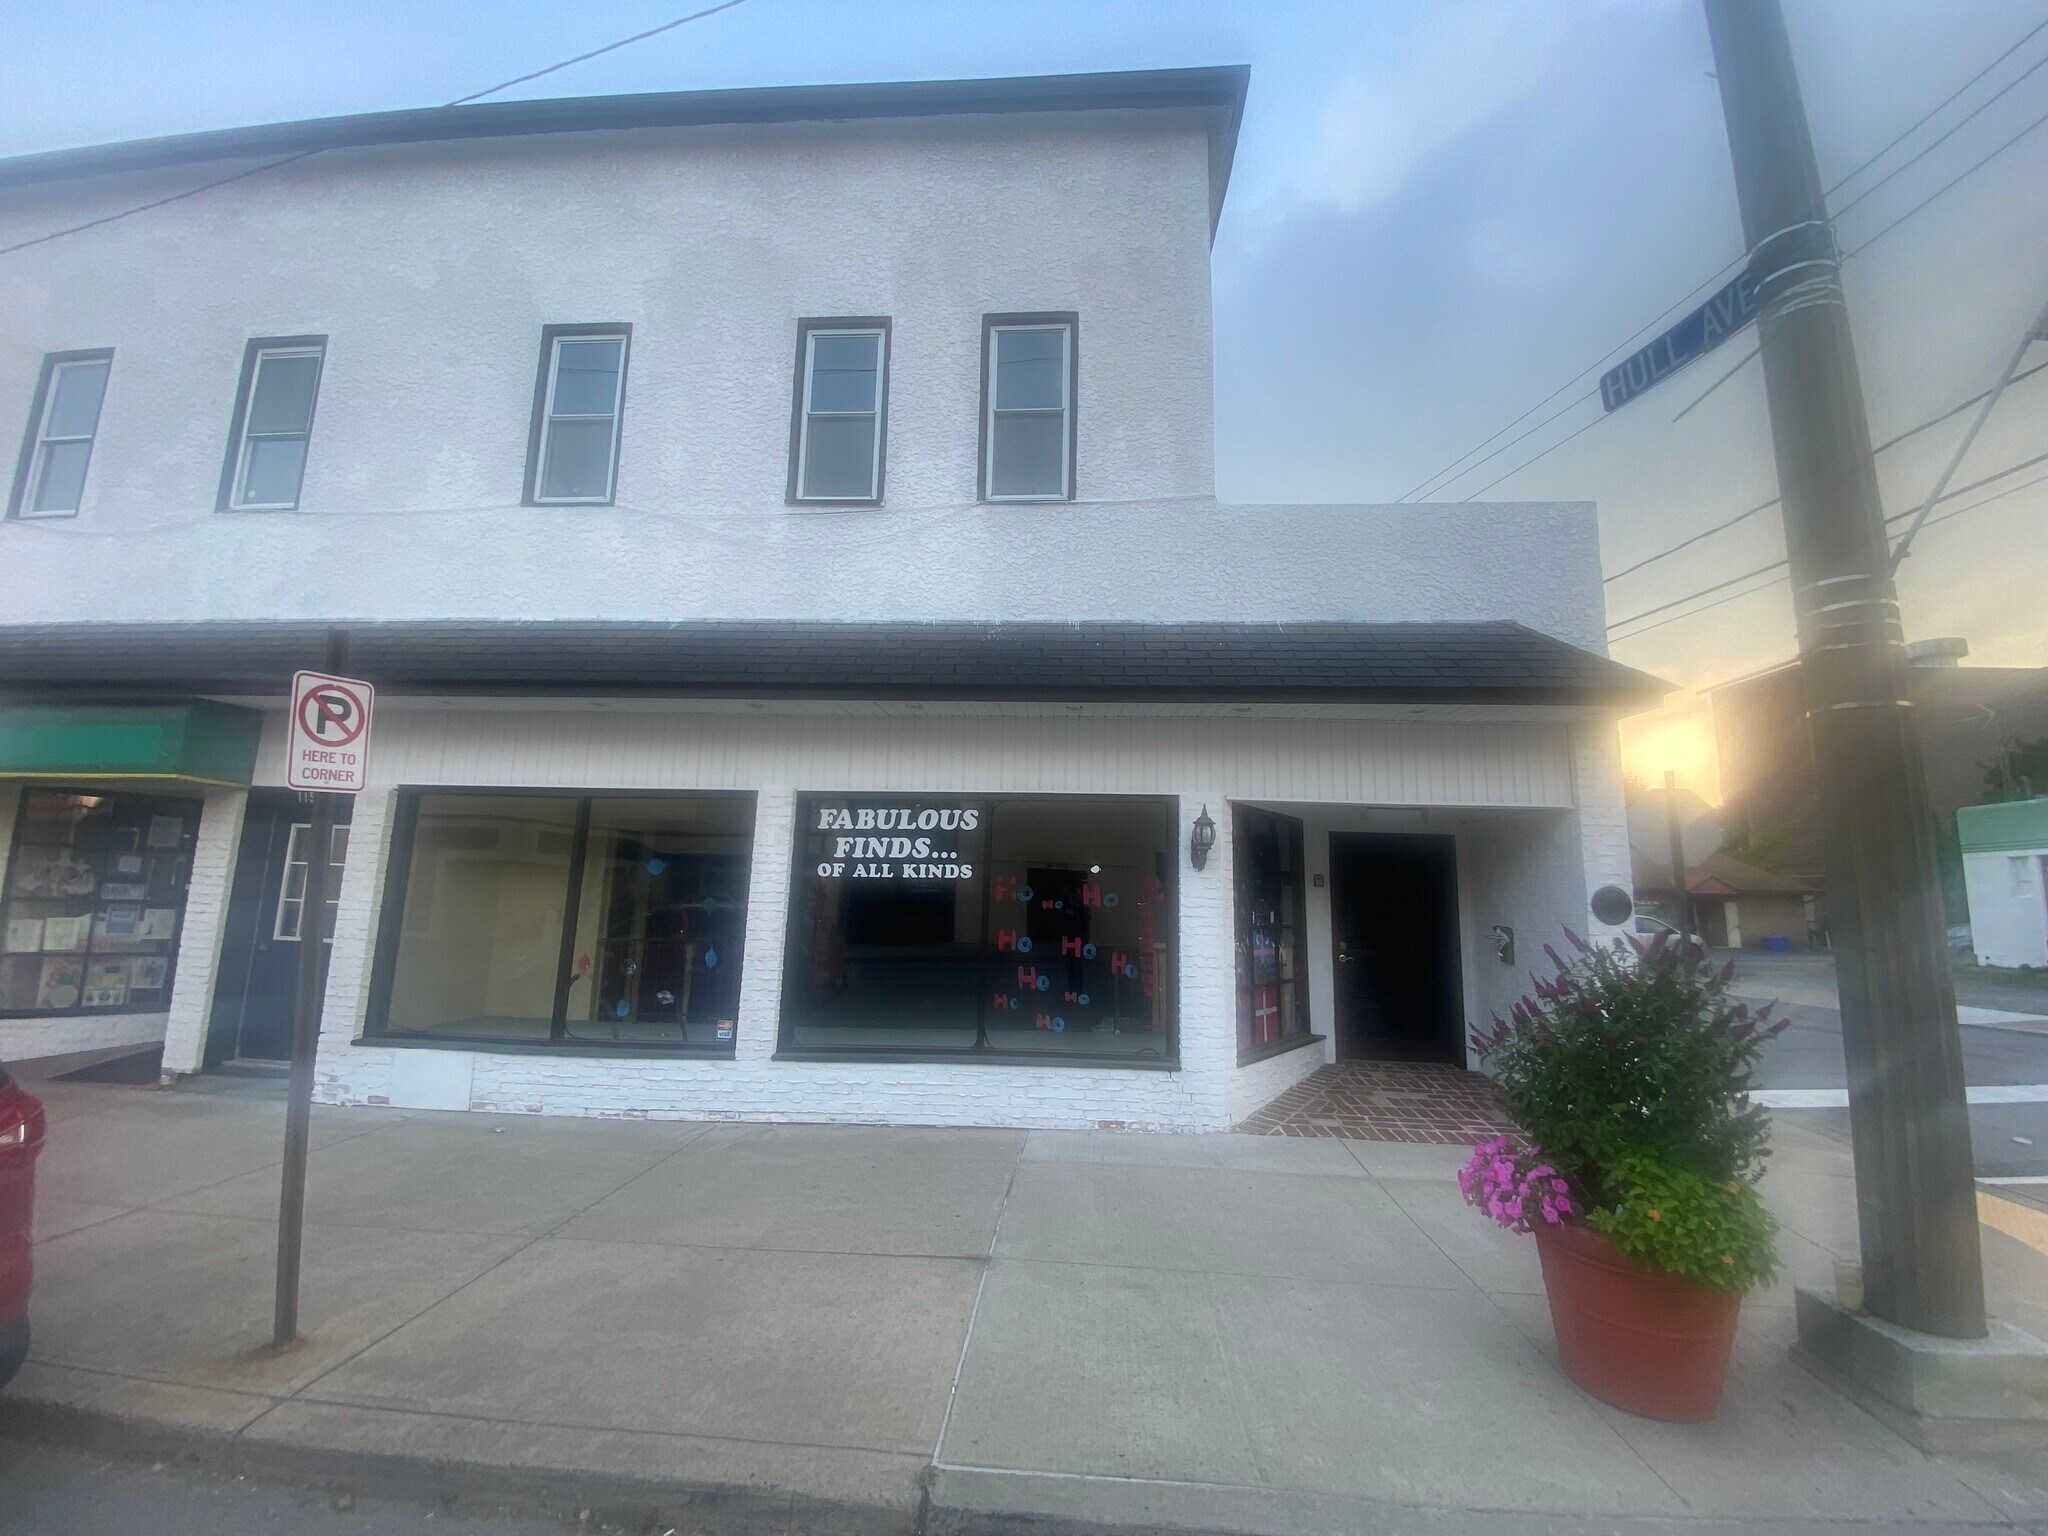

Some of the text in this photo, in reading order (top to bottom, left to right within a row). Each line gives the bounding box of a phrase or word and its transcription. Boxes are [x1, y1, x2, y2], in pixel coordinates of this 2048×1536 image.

[1604, 273, 1756, 408] HULL AVE
[316, 694, 352, 735] P
[302, 749, 356, 766] HERE TO
[302, 767, 355, 783] CORNER
[817, 808, 979, 831] FABULOUS
[833, 837, 958, 859] FINDS...
[817, 862, 973, 879] OF ALL KINDS
